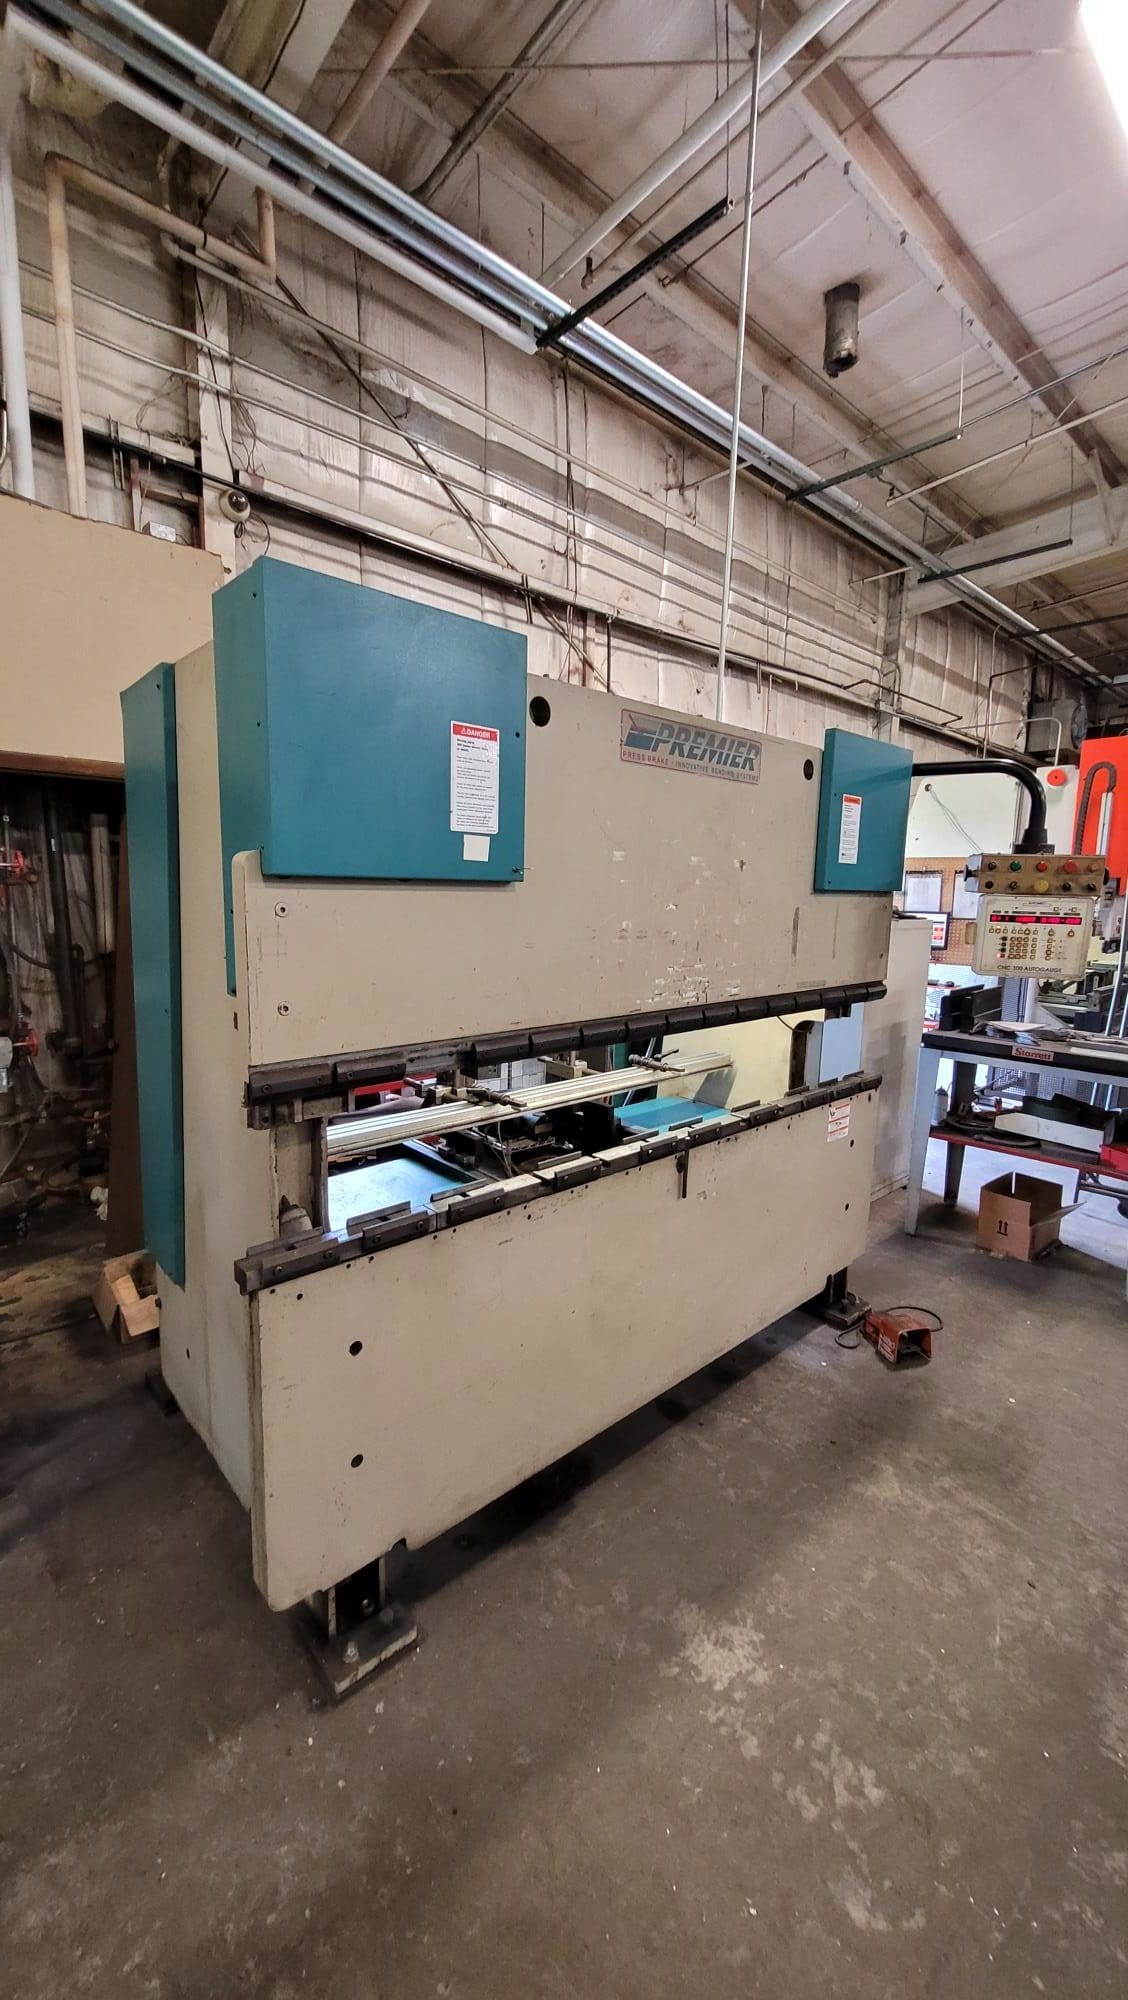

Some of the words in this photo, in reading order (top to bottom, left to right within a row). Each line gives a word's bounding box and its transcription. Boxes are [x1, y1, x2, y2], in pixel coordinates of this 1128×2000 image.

[466, 728, 491, 739] DANGER
[649, 722, 761, 771] PREMIER
[622, 750, 646, 762] PRESS
[647, 754, 669, 766] BRAKE
[675, 760, 709, 774] INNOVATIVE
[711, 767, 735, 778] BENDING
[736, 770, 760, 782] SYSTEMS
[1014, 1047, 1052, 1060] Starrett
